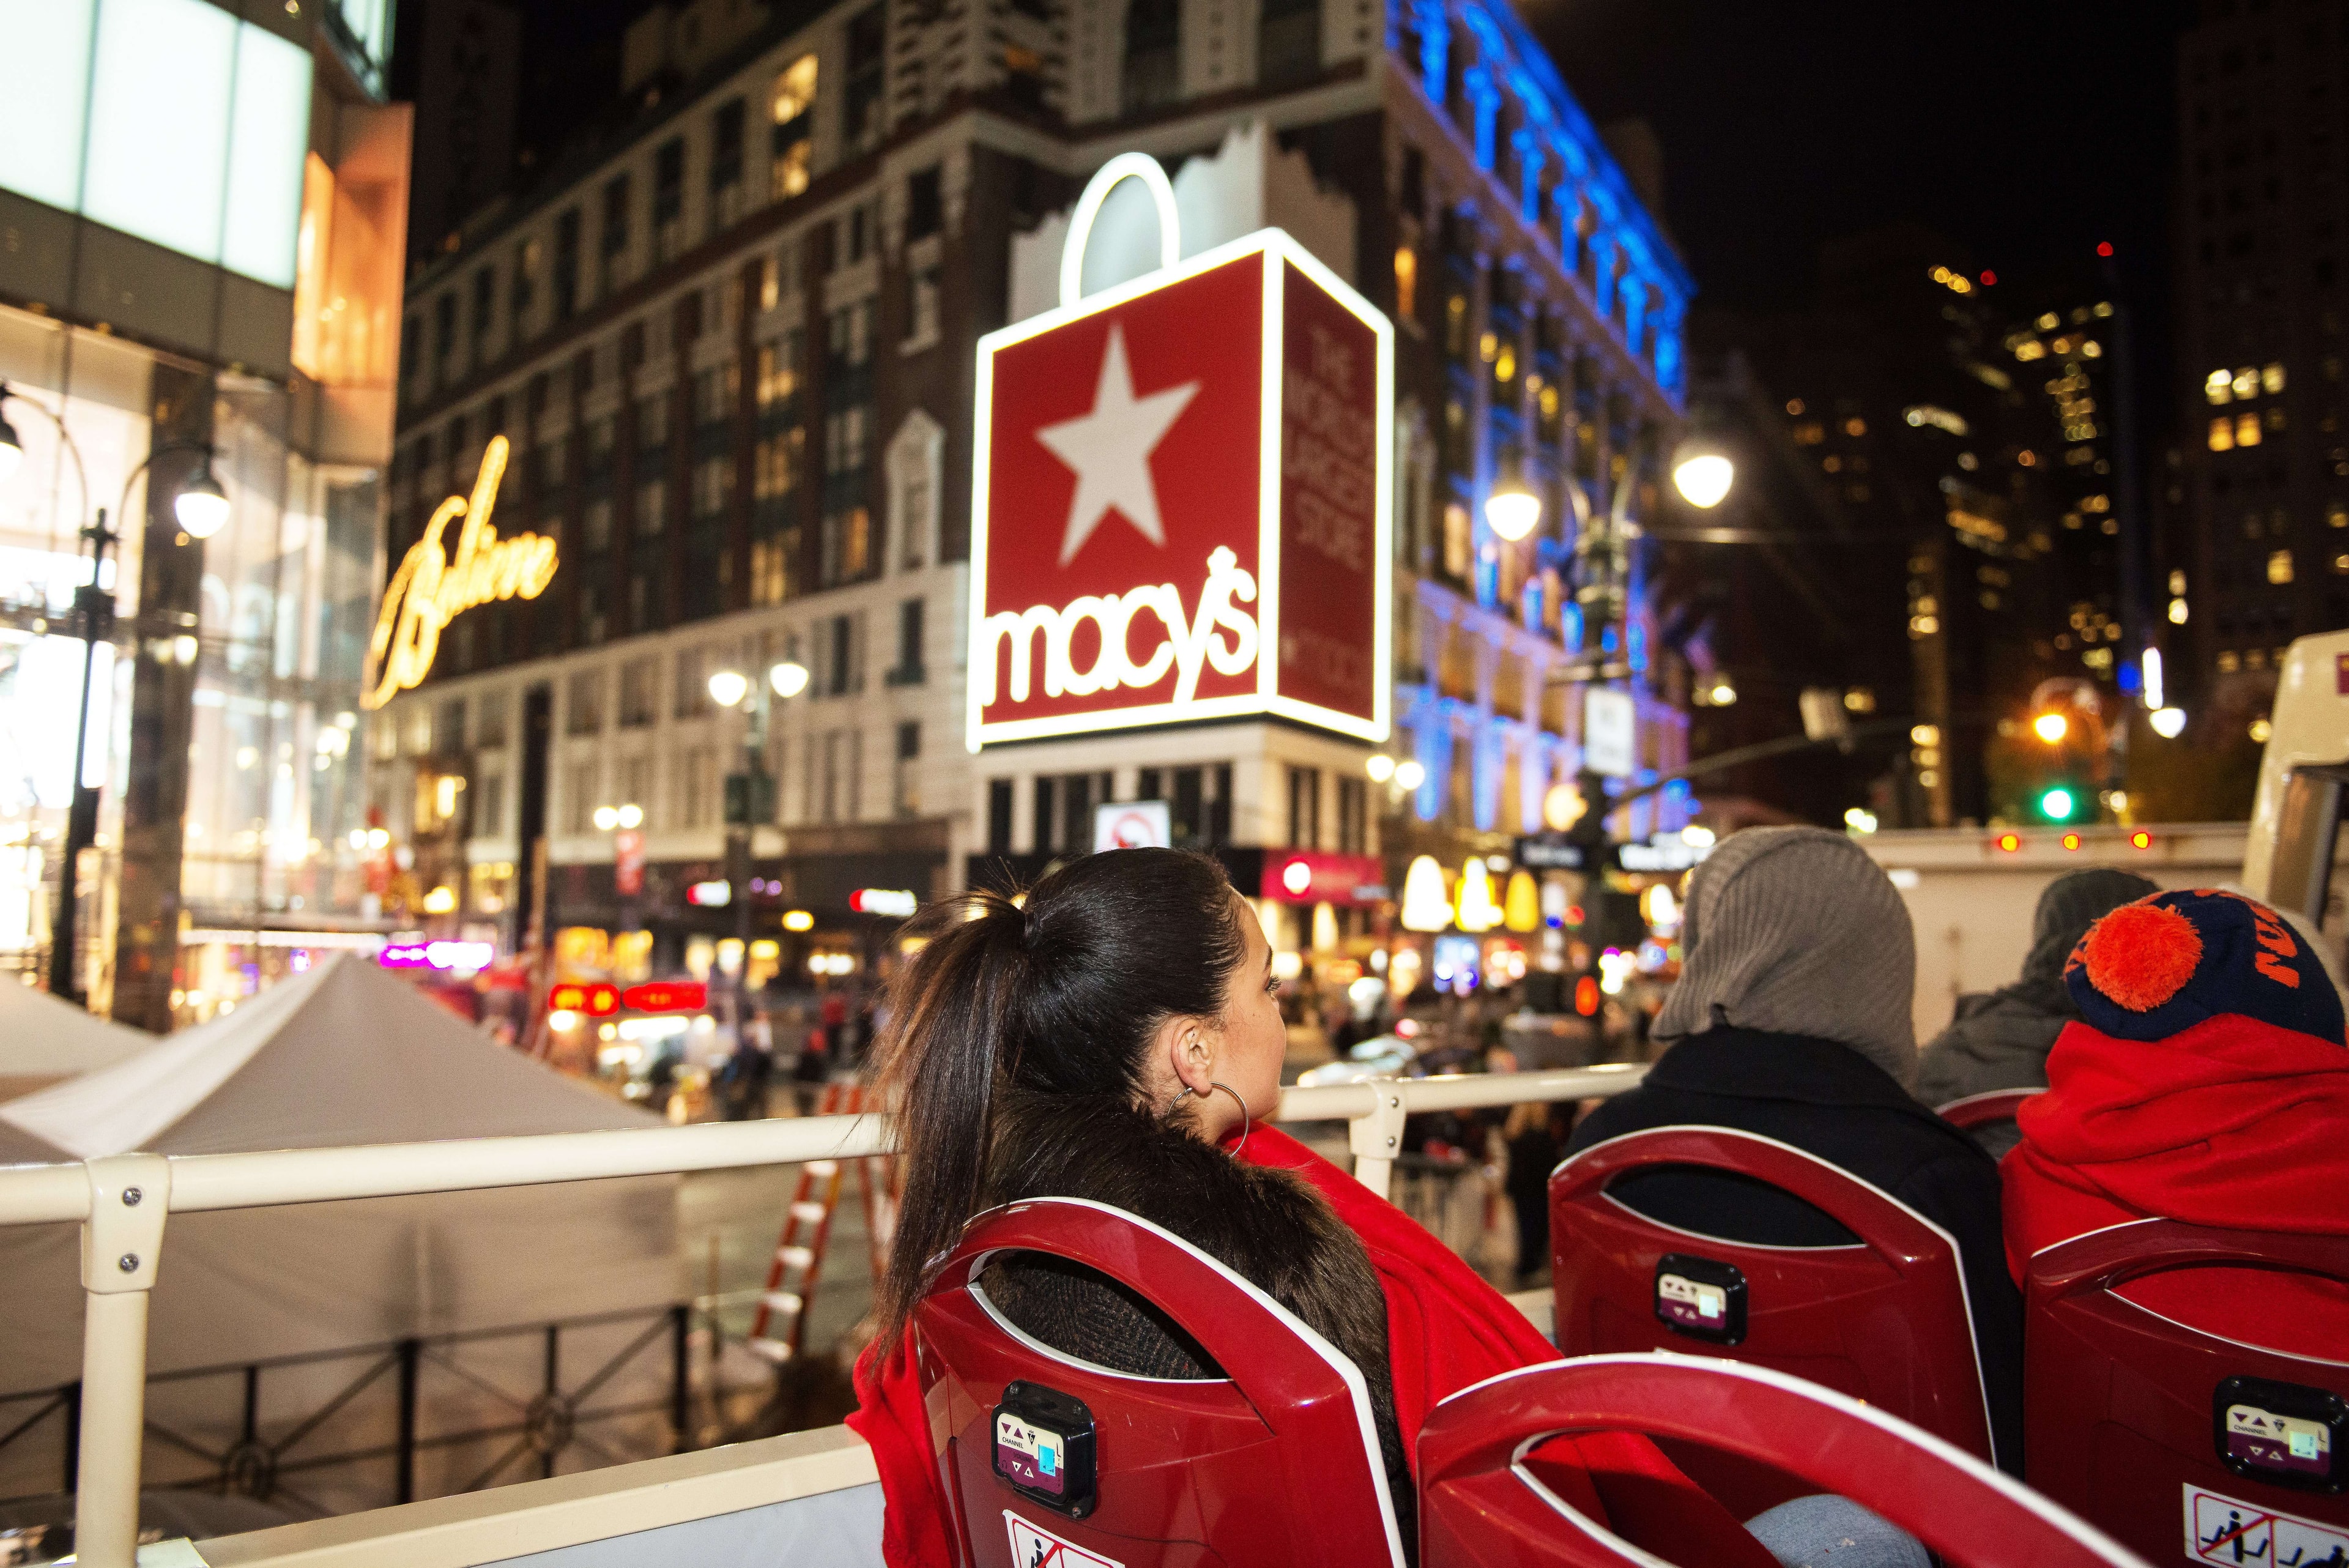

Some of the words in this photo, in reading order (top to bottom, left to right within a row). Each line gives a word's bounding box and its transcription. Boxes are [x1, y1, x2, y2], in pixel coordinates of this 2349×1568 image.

[982, 544, 1258, 703] macy's
[2234, 1424, 2267, 1436] CHANNEL
[1002, 1436, 1024, 1449] CHANNEL
[1013, 1452, 1033, 1463] VOLUME
